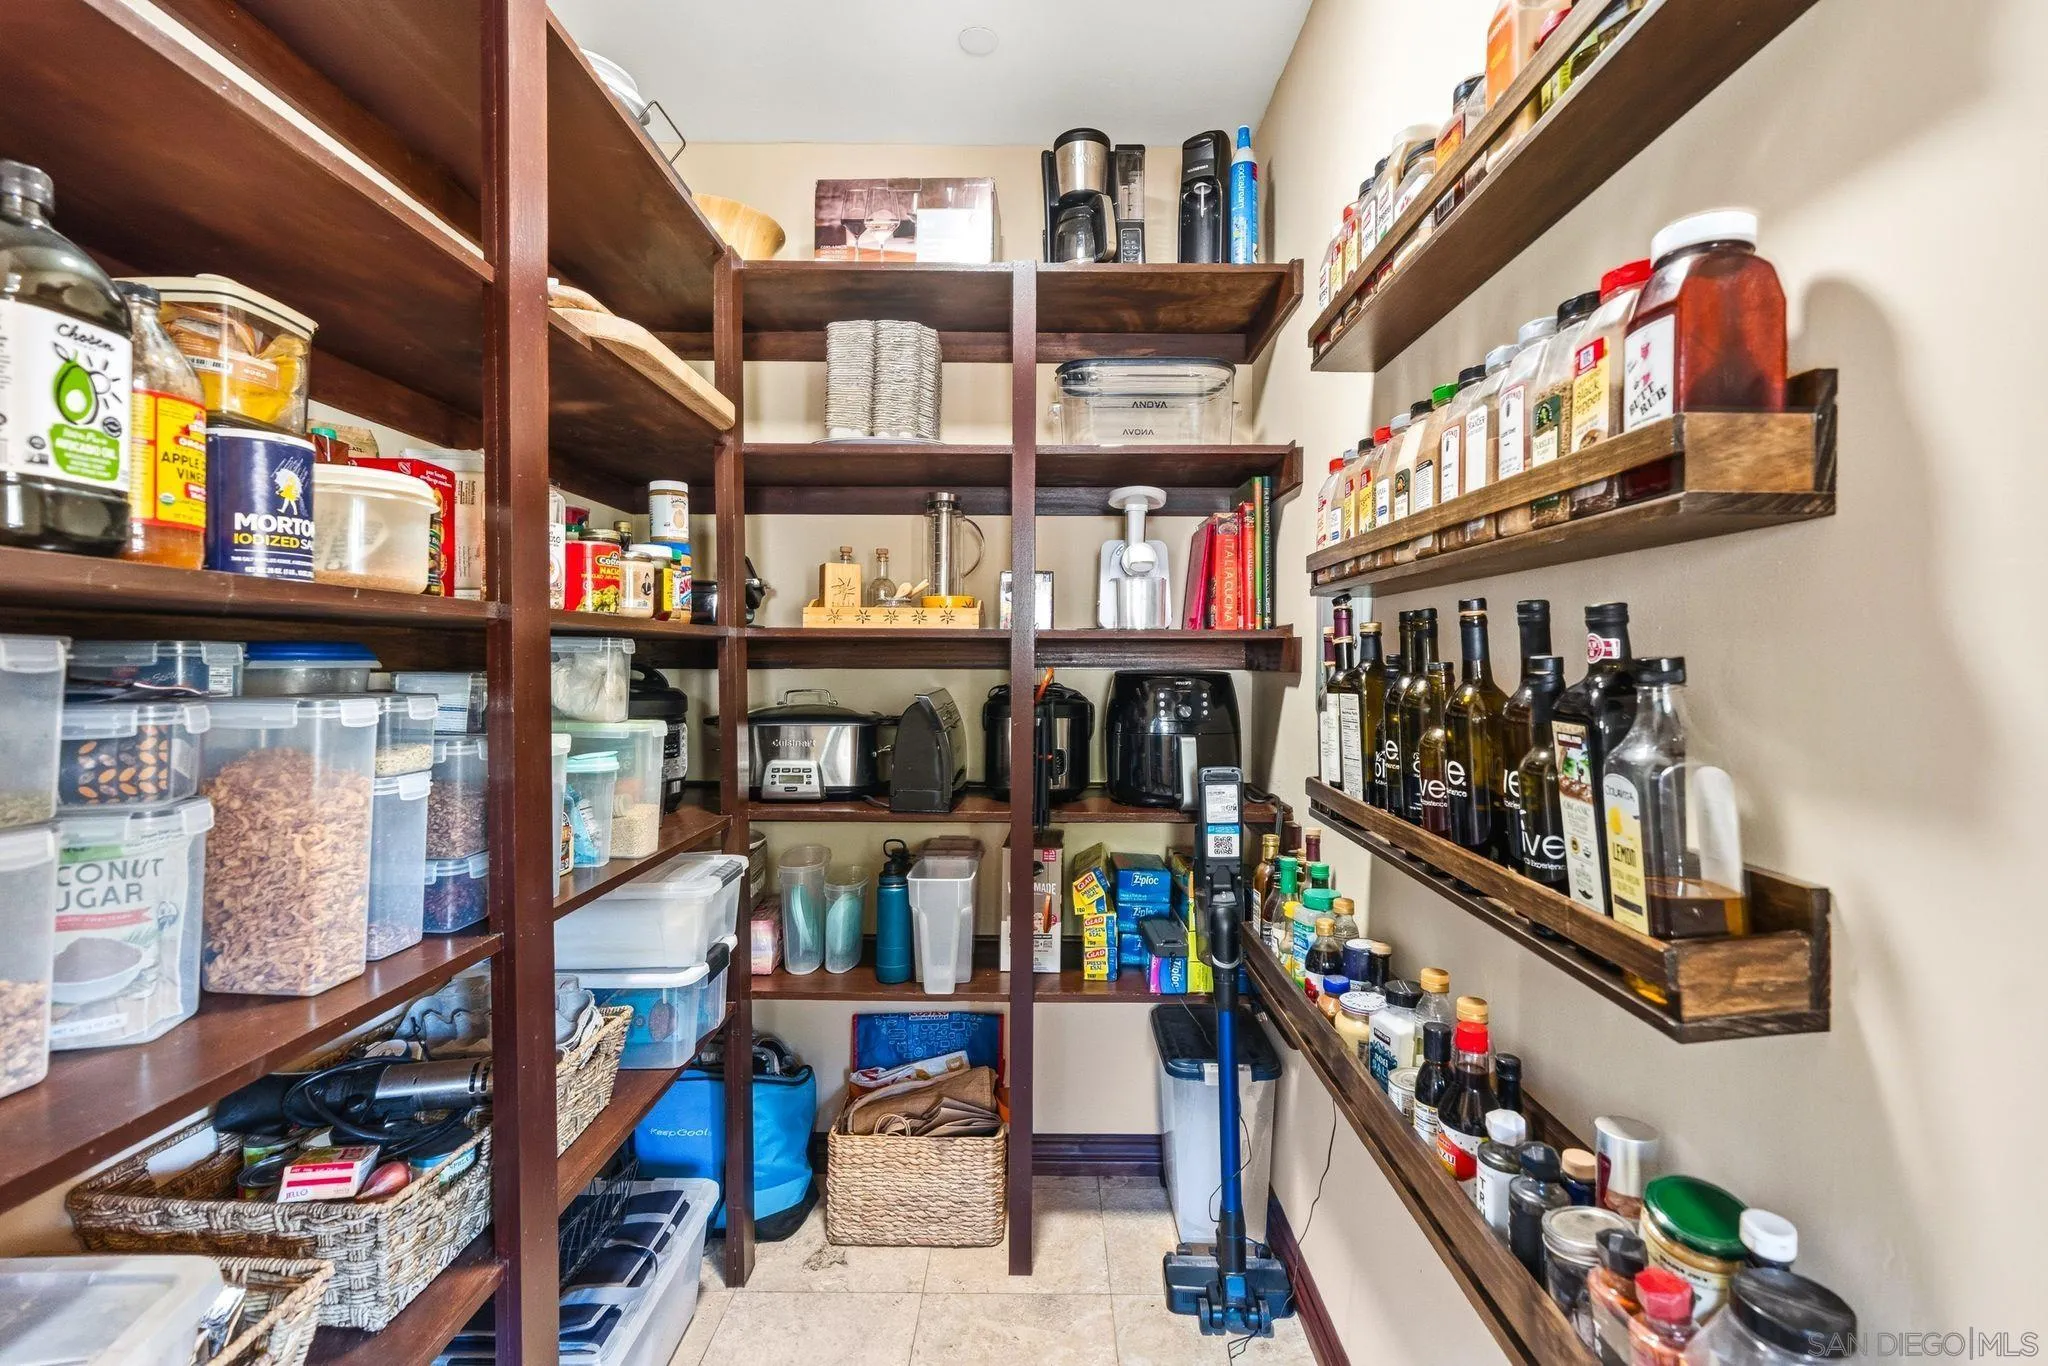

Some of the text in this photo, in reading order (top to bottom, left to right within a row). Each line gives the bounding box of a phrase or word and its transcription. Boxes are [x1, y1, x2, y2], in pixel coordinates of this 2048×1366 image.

[1132, 401, 1168, 409] ANOVA
[161, 451, 200, 470] APPLE
[233, 532, 301, 549] IODIZED
[772, 739, 816, 748] Cuisinart
[1612, 842, 1638, 869] LEMON
[1134, 873, 1160, 888] Ziploc
